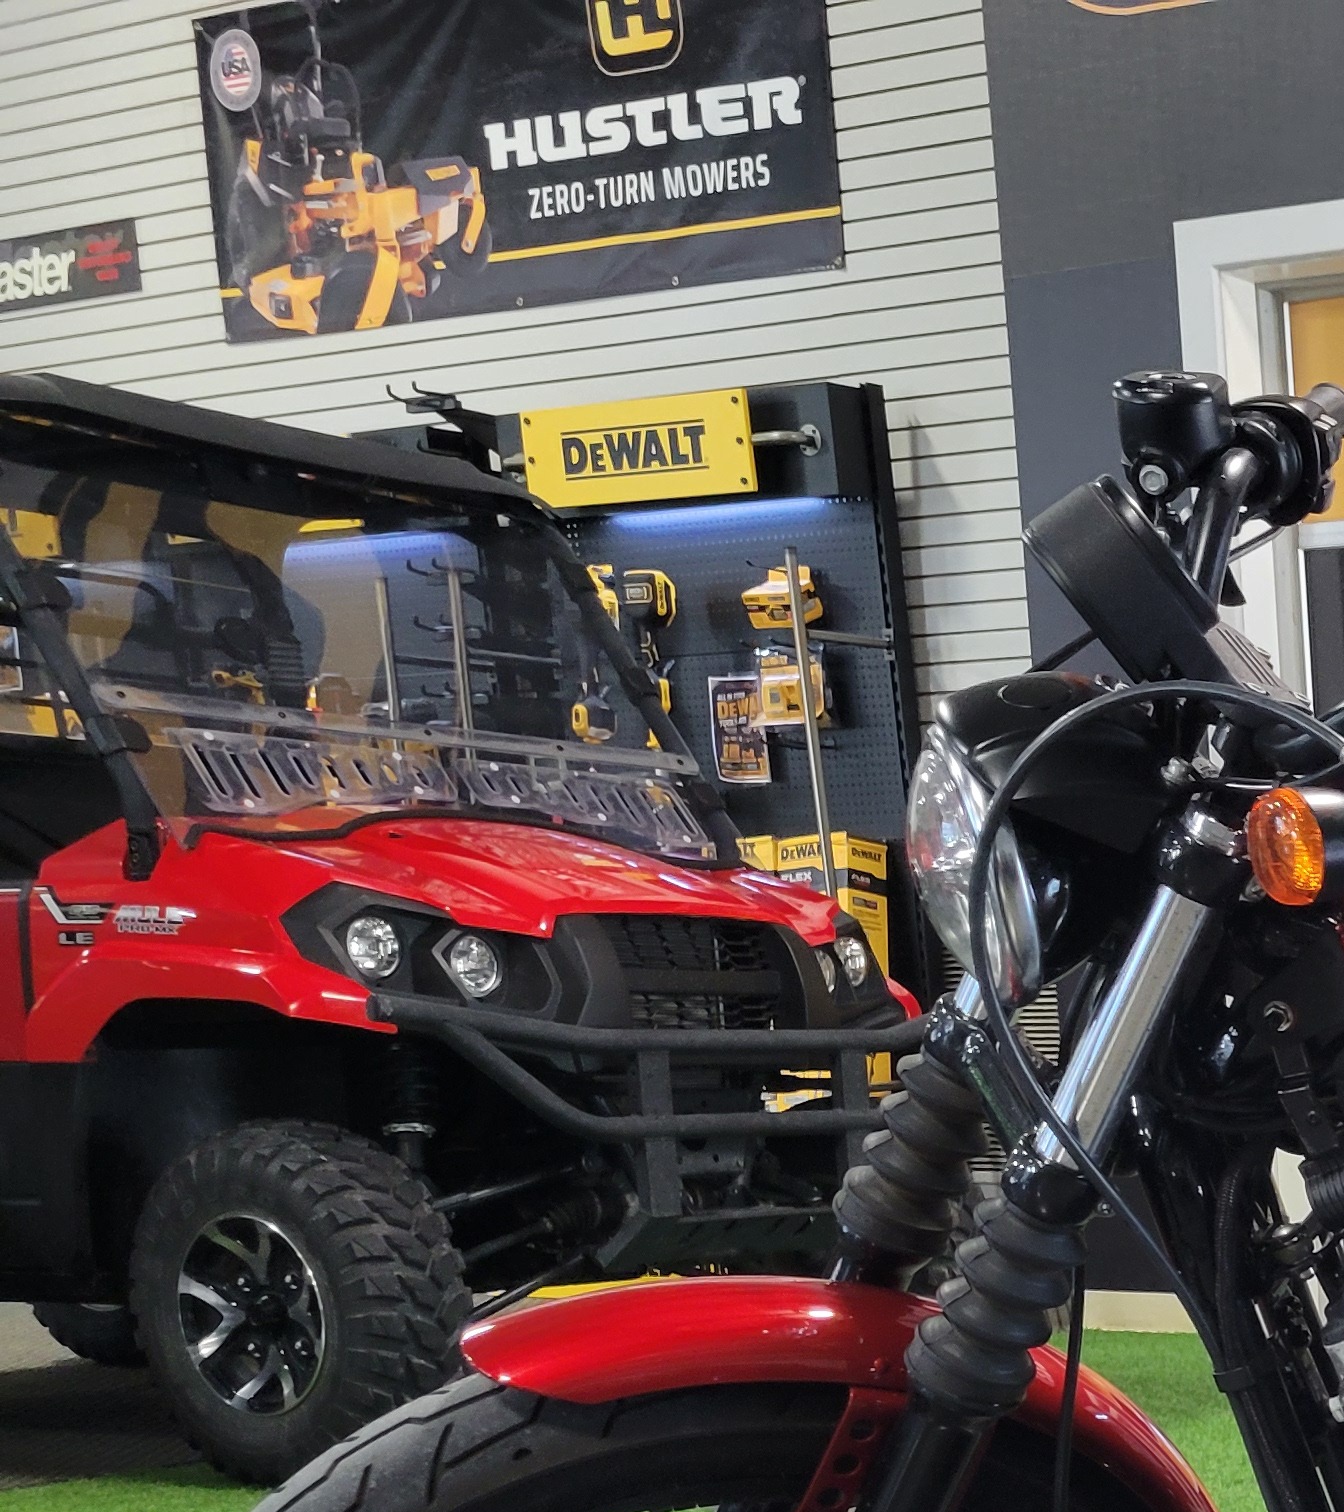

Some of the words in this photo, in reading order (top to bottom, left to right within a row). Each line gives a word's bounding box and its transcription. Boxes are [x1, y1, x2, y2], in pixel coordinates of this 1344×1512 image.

[221, 57, 251, 78] USA
[484, 76, 803, 171] HUSTLER
[528, 171, 655, 219] ZERO-TURN
[663, 154, 770, 199] MOWERS
[58, 932, 94, 945] LE
